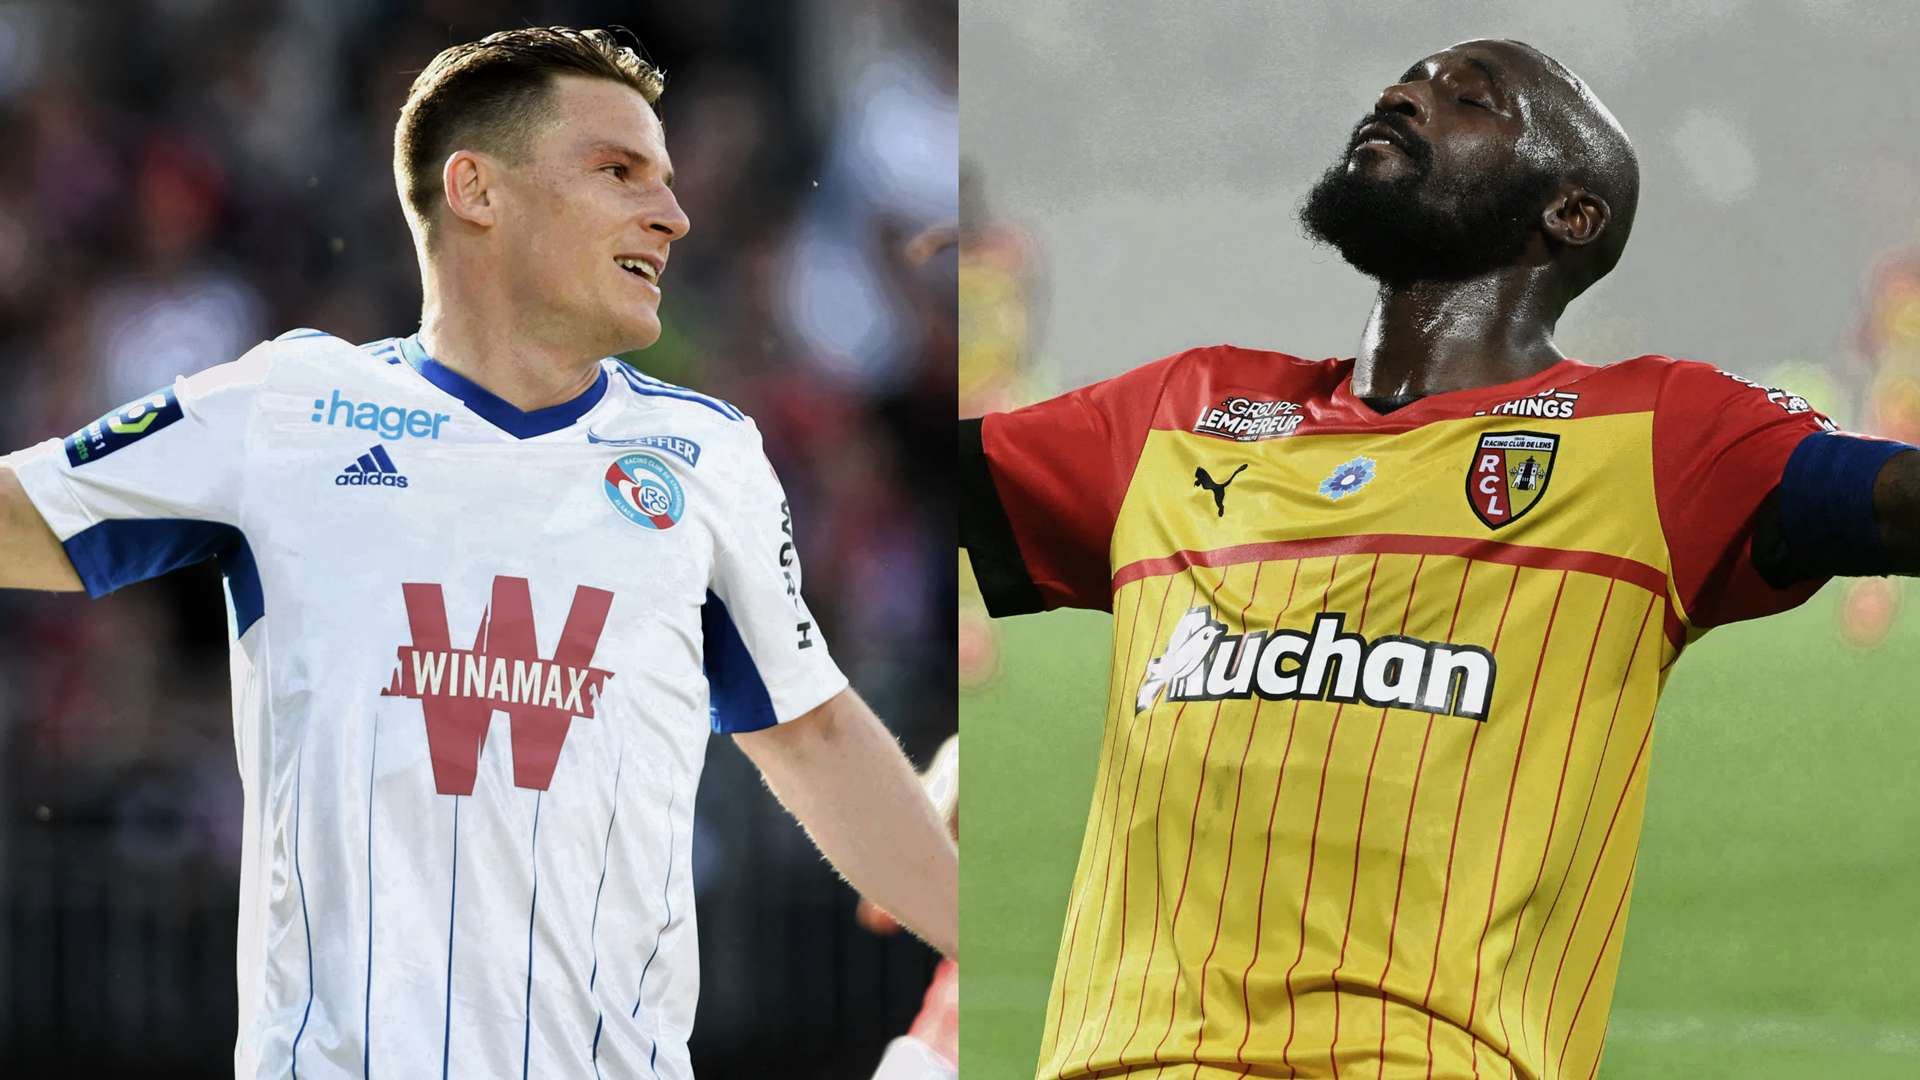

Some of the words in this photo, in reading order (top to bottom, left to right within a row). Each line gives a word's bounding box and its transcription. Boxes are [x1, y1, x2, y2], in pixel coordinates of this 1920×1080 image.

[1194, 404, 1305, 435] LEMPEREUR
[1227, 398, 1303, 418] GROUPE
[1484, 439, 1507, 448] RACING
[1508, 440, 1525, 448] CLUB
[1526, 441, 1535, 449] DE
[1535, 441, 1552, 449] LENS
[335, 471, 409, 488] adidas
[1137, 605, 1497, 722] Auchan
[411, 650, 590, 714] WINAMAX
